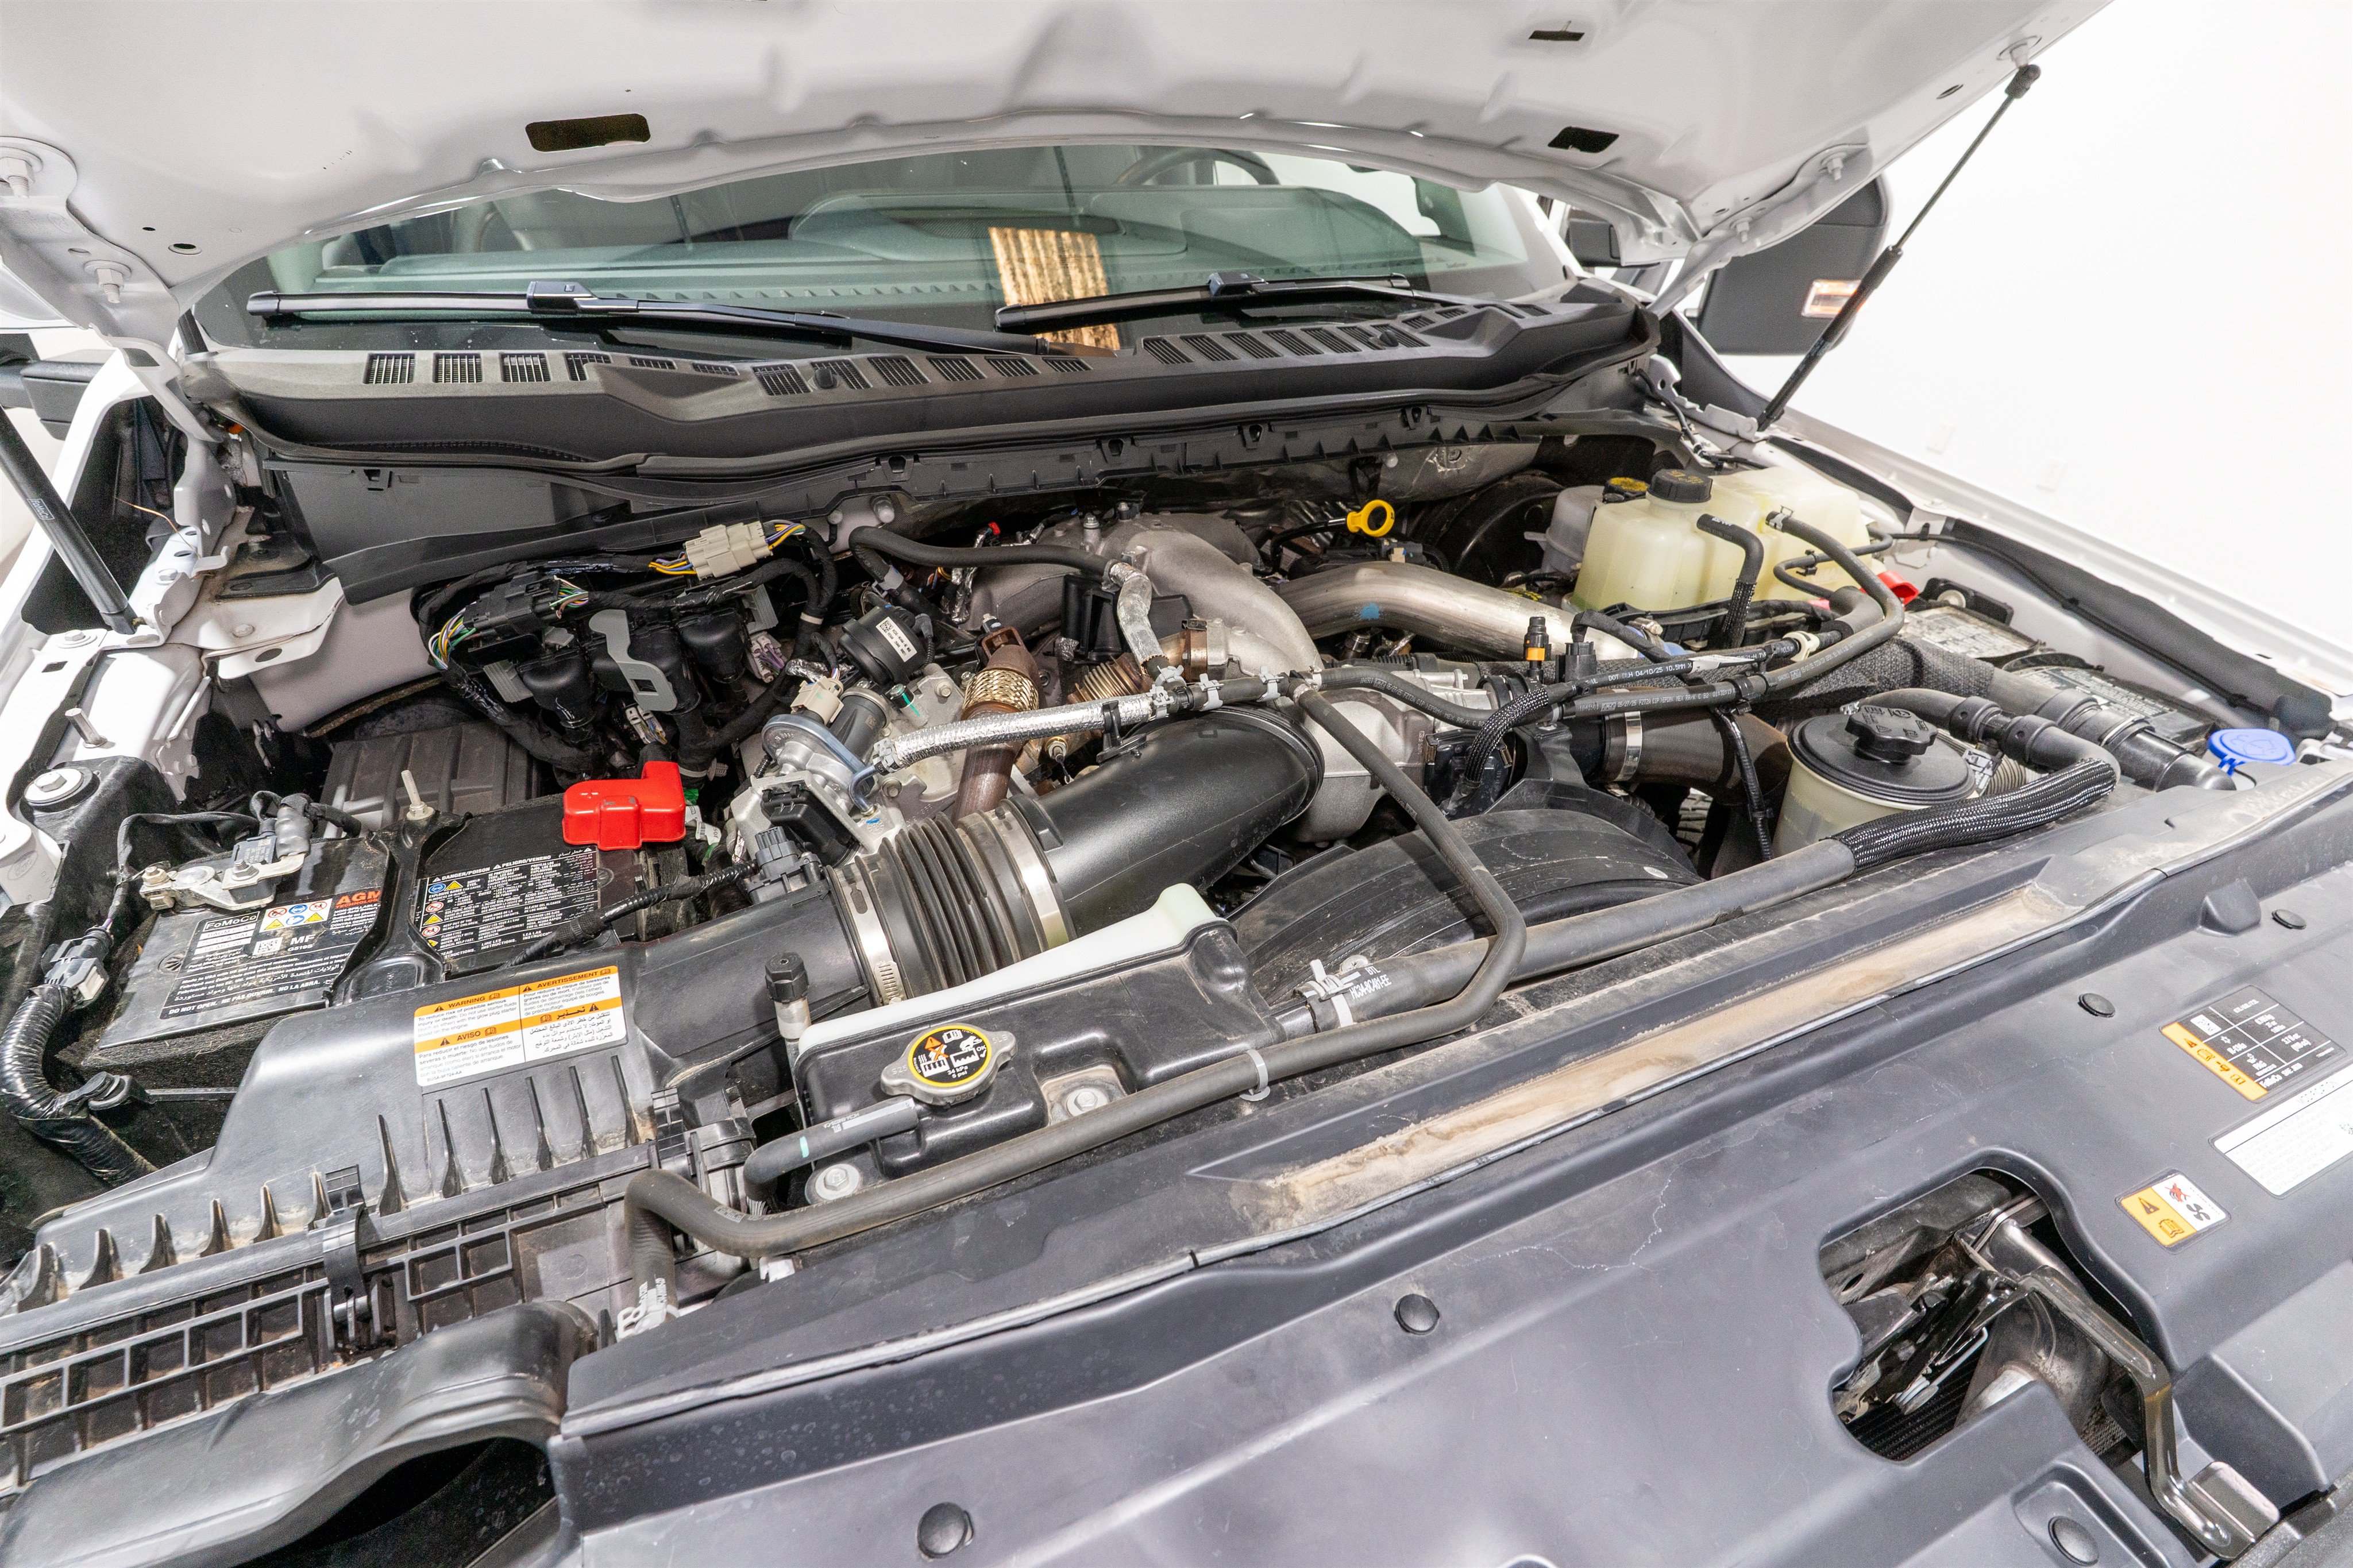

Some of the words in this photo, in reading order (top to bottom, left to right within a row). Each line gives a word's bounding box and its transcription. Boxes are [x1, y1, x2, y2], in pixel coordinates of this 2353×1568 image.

[31, 500, 48, 519] FoMoCo
[1608, 674, 1619, 682] DOT
[502, 854, 551, 867] PELIGRO/VENENO
[441, 867, 490, 880] DANGER/POISON
[205, 914, 257, 929] FoMoCo
[288, 933, 316, 945] MF
[537, 971, 598, 988] AVERTISSEMENT
[586, 975, 610, 983] blessures
[196, 1001, 218, 1009] OPEN.
[244, 987, 276, 998] OUVRIR.
[299, 979, 322, 987] ABRA.
[448, 996, 485, 1008] WARNING
[464, 1003, 485, 1013] possible
[457, 1030, 480, 1041] AVISO
[433, 1047, 452, 1056] reducir
[487, 1035, 508, 1043] lesiones
[419, 1056, 440, 1064] severas
[448, 1050, 468, 1058] muerte:
